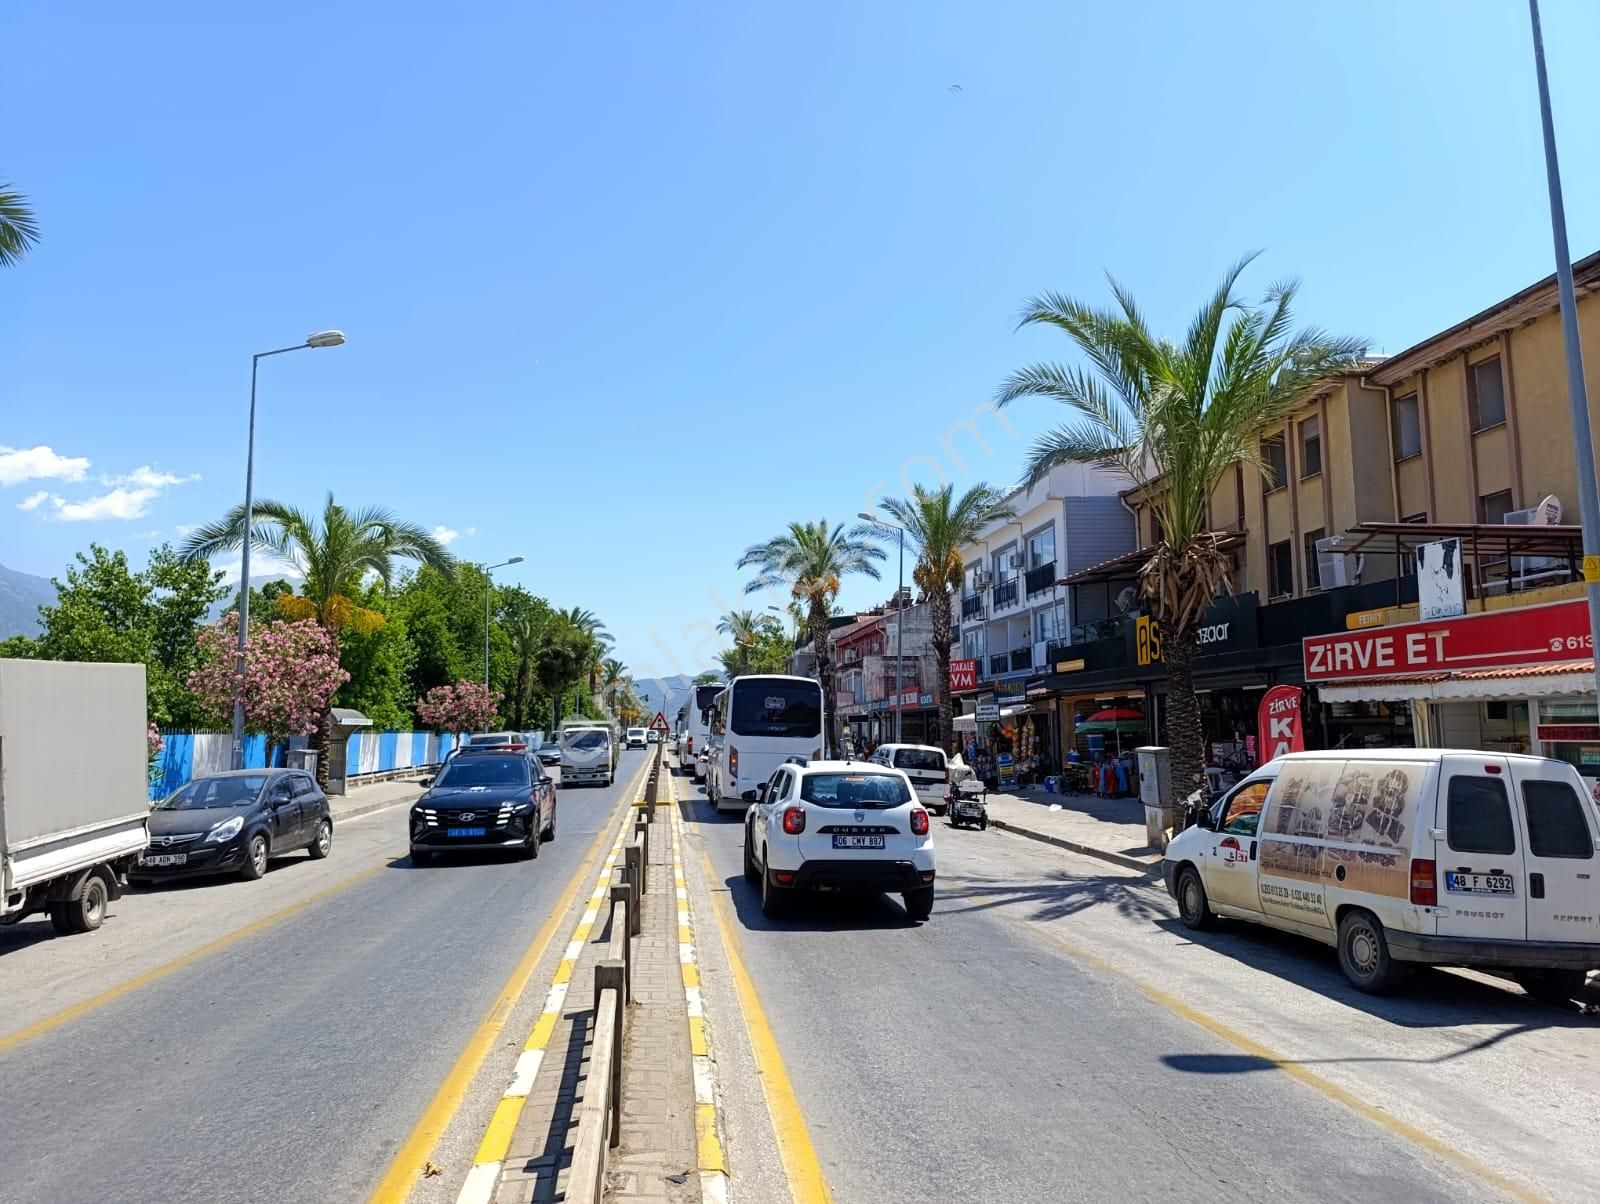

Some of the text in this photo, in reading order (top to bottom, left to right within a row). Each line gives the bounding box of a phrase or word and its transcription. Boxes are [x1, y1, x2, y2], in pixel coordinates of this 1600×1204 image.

[1406, 629, 1451, 665] ET
[950, 672, 972, 687] VM
[838, 836, 847, 846] 06
[1453, 874, 1512, 889] 48 F 6292
[1456, 909, 1506, 919] PEUGEOT
[1553, 914, 1593, 923] EXPERT
